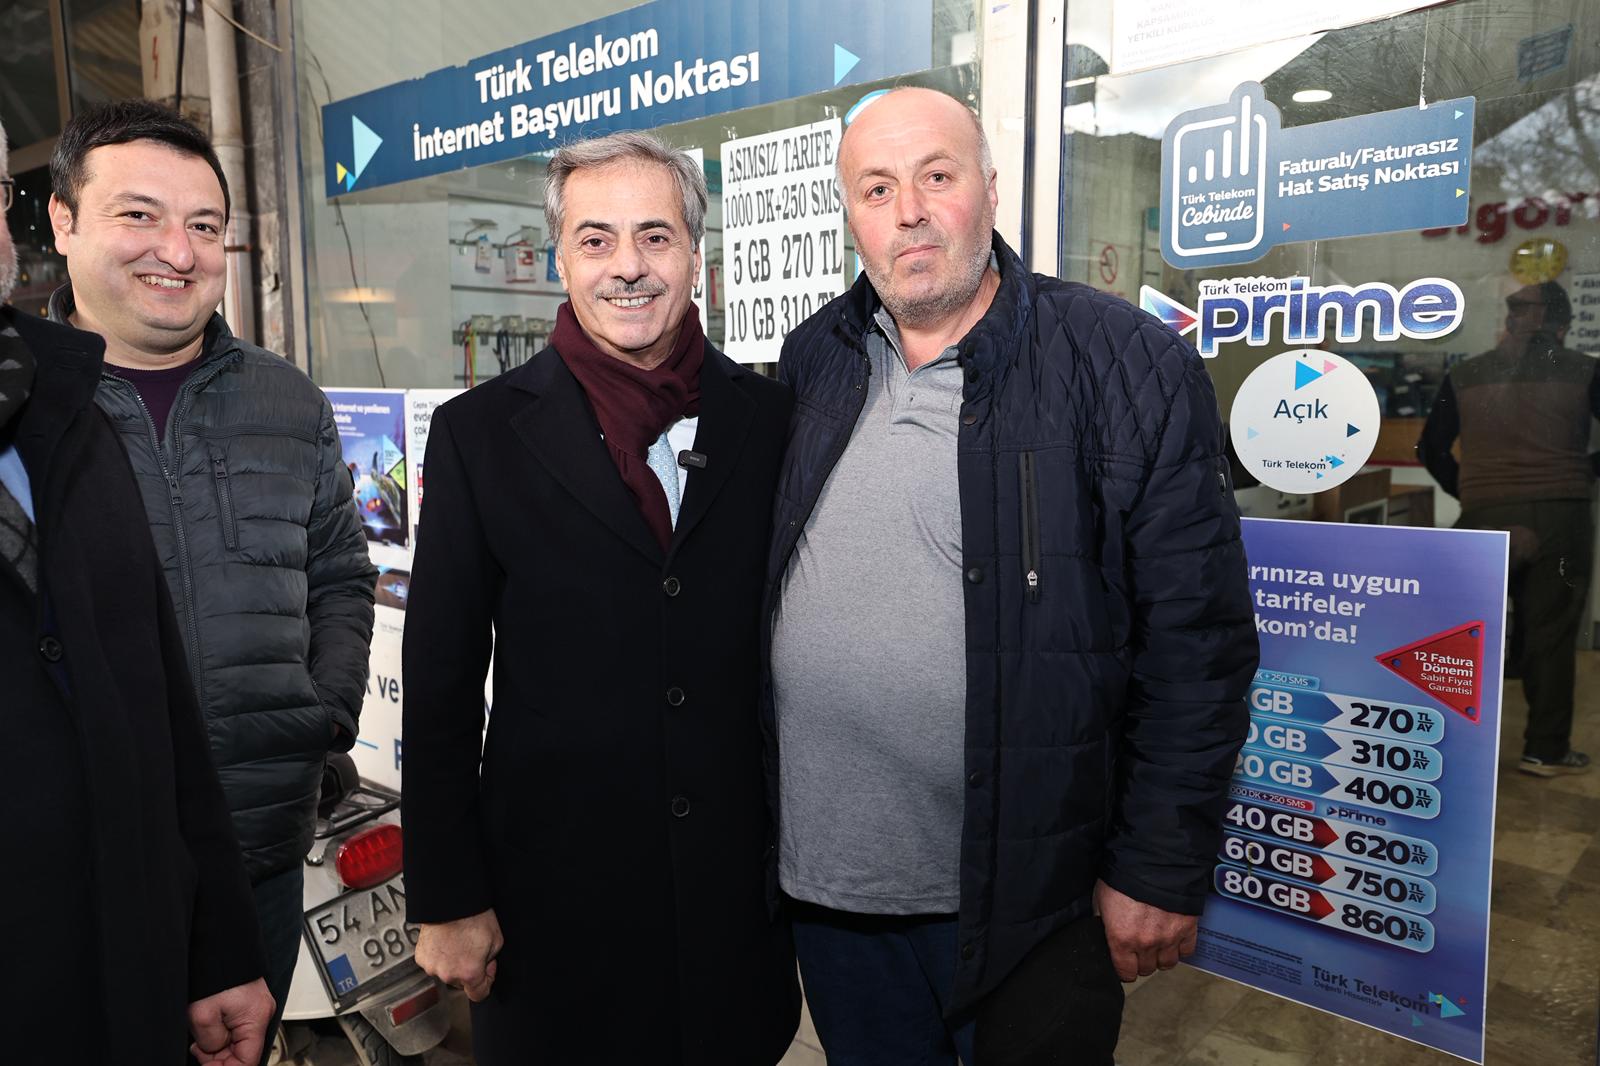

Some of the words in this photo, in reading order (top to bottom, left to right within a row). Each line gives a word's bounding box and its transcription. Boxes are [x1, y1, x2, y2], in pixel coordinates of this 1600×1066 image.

[474, 58, 533, 104] Türk
[536, 27, 658, 87] Telekom
[412, 122, 505, 162] İnternet
[510, 86, 621, 139] Başvuru
[630, 51, 760, 111] Noktası
[783, 123, 833, 173] TARİFE
[1278, 136, 1460, 177] Faturalı/Faturasız
[1278, 178, 1314, 198] Hat
[1317, 170, 1370, 193] Satış
[1374, 159, 1460, 186] Noktası
[724, 190, 752, 229] 1000
[811, 176, 842, 217] SMS
[1181, 192, 1206, 206] Türk
[1208, 186, 1256, 203] Telekom
[1181, 200, 1255, 228] Cebinde
[733, 239, 743, 285] 5
[749, 238, 771, 284] GB
[782, 230, 814, 280] 270
[819, 228, 843, 276] TL
[1203, 284, 1230, 296] Türk
[1233, 279, 1288, 294] Telekom
[729, 296, 748, 343] 10
[752, 296, 775, 341] GB
[1199, 277, 1458, 354] prime
[1273, 398, 1329, 424] Açık
[1262, 459, 1283, 469] Türk
[1285, 458, 1326, 470] Telekom
[1248, 565, 1325, 588] rınıza
[1332, 572, 1421, 597] uygun
[1255, 588, 1366, 617] tarifeler
[1413, 651, 1427, 662] 12
[1430, 653, 1474, 668] Fatura
[1422, 662, 1474, 678] Dönemi
[377, 675, 400, 704] ve
[1271, 673, 1287, 683] 250
[1288, 676, 1309, 687] SMS
[1420, 672, 1447, 684] Sabit
[1448, 676, 1473, 688] Fiyat
[1428, 683, 1473, 696] Garantisi
[1250, 687, 1294, 715] GB
[1350, 702, 1414, 734] 270
[1417, 712, 1432, 722] TL
[1416, 723, 1435, 733] AY
[1263, 725, 1307, 753] GB
[1351, 739, 1411, 772] 310
[1413, 750, 1428, 761] TL
[1412, 761, 1431, 770] AY
[1248, 790, 1261, 800] DK
[1269, 794, 1286, 805] 250
[1286, 798, 1307, 809] SMS
[1269, 760, 1313, 788] GB
[1344, 777, 1415, 810] 400
[1416, 787, 1431, 798] TL
[1338, 807, 1387, 827] prime
[1415, 798, 1434, 809] AY
[1225, 804, 1266, 831] 40
[1270, 813, 1314, 842] GB
[1344, 830, 1411, 865] 620
[1412, 844, 1426, 855] TL
[1225, 837, 1266, 865] 60
[1270, 848, 1314, 878] GB
[1344, 866, 1408, 903] 750
[1409, 882, 1424, 893] TL
[1411, 855, 1430, 865] AY
[1223, 871, 1263, 899] 80
[1267, 883, 1311, 913] GB
[1341, 904, 1409, 941] 860
[1409, 920, 1425, 931] TL
[1408, 893, 1428, 904] AY
[316, 905, 361, 946] 54
[1408, 931, 1426, 942] AY
[363, 921, 421, 968] 986
[338, 977, 354, 993] TR
[1311, 965, 1349, 989] Türk
[1354, 977, 1430, 1015] Telekom
